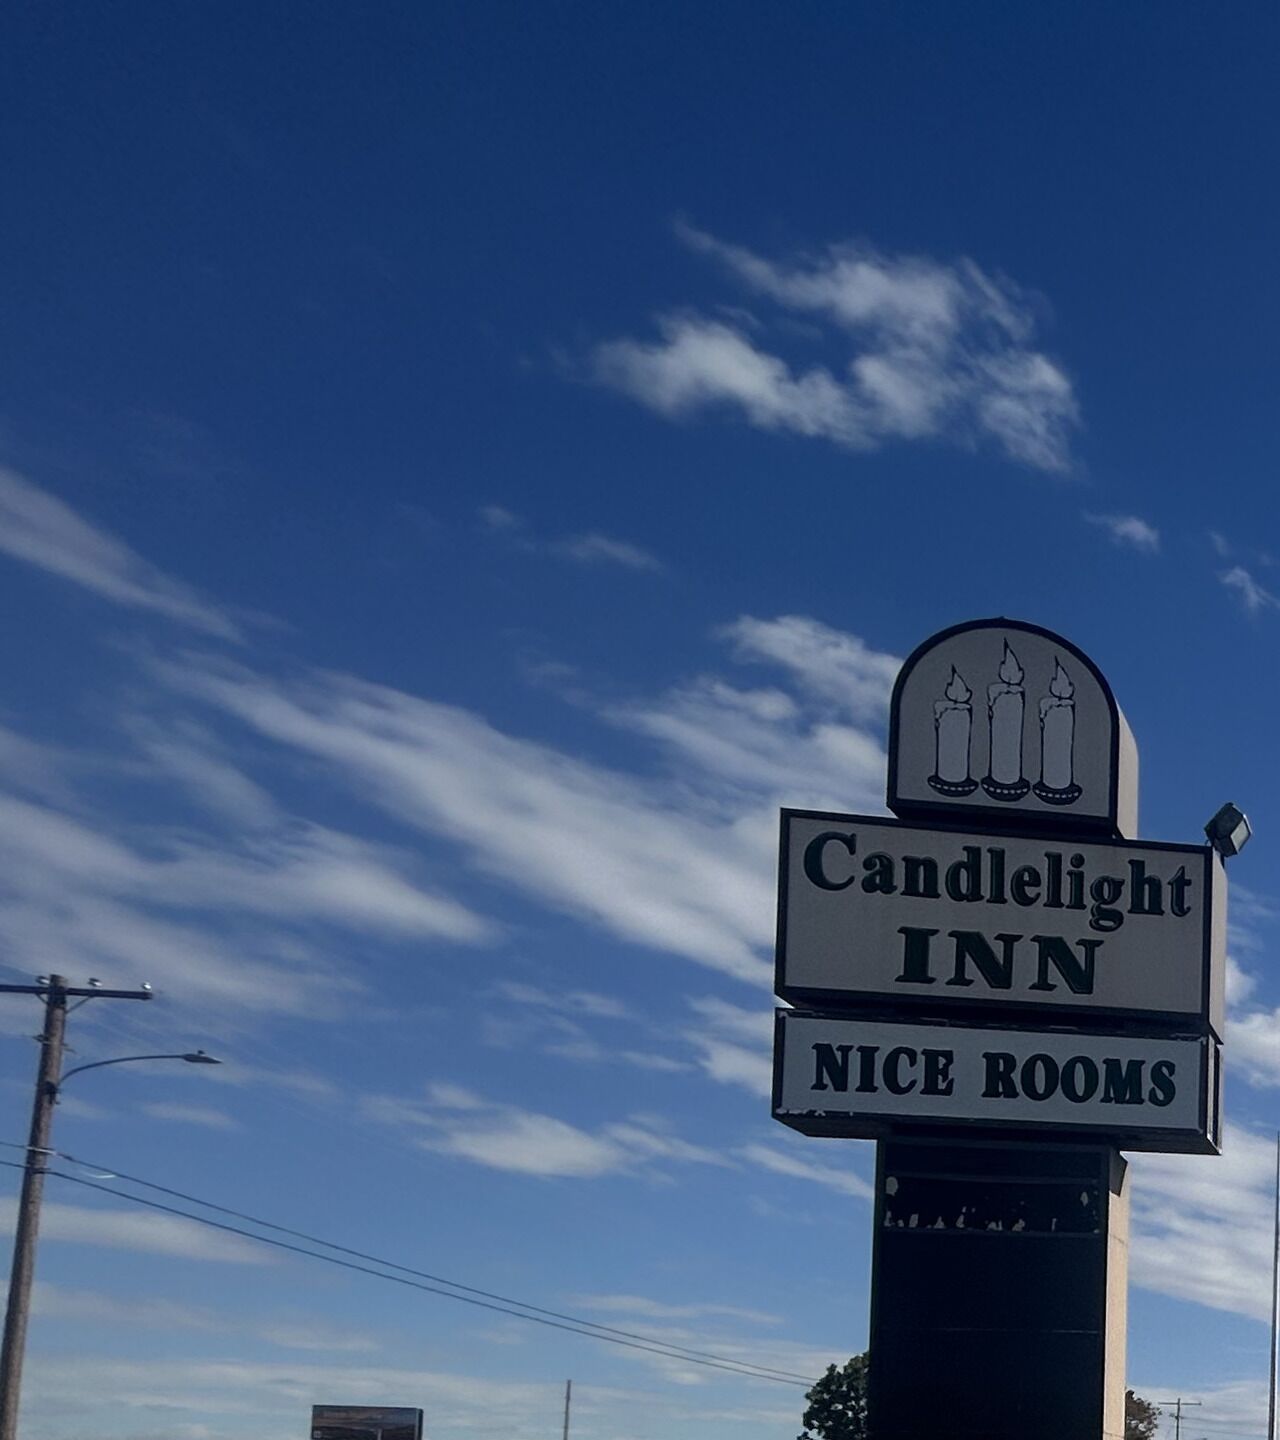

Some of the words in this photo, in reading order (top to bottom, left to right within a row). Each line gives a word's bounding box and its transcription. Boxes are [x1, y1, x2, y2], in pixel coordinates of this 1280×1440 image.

[803, 831, 1193, 931] Candlelight
[895, 925, 1104, 996] INN
[811, 1042, 954, 1097] NICE
[981, 1050, 1177, 1107] ROOMS
